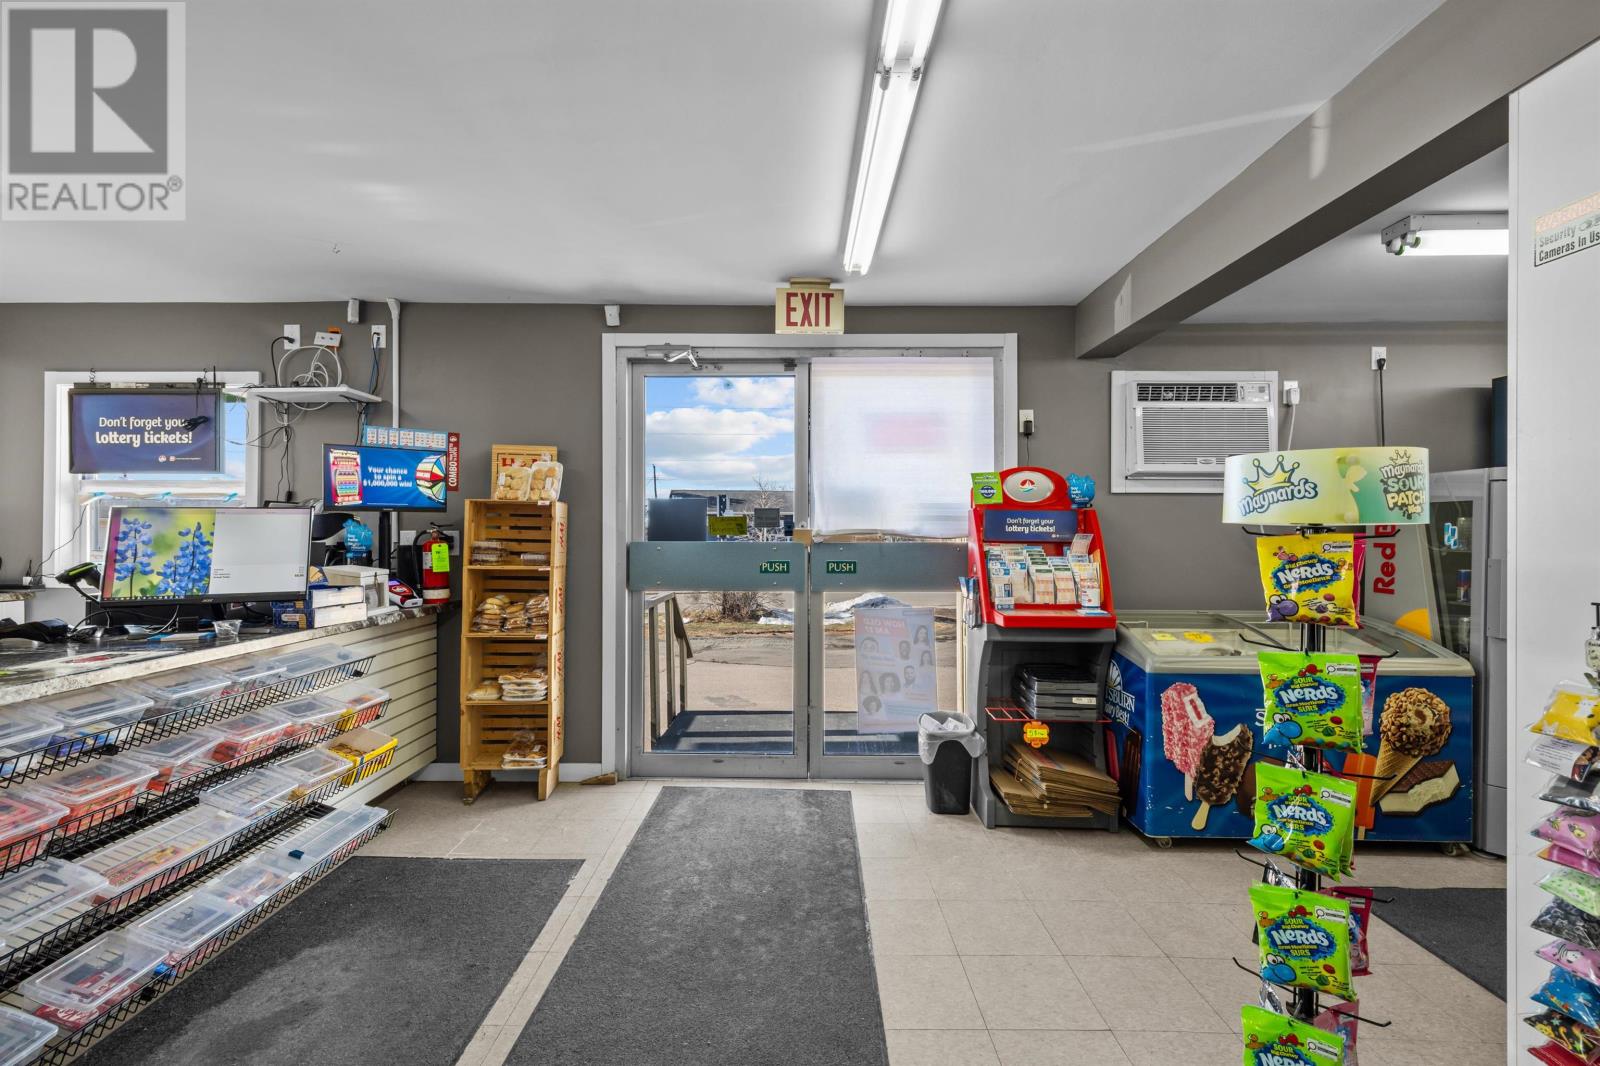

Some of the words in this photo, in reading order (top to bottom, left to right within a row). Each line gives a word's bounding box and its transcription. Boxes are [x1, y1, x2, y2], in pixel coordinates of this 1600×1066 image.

[1540, 224, 1577, 247] Security
[1539, 240, 1576, 262] Cameras
[1578, 236, 1587, 247] In
[1589, 230, 1600, 244] Us
[785, 292, 834, 327] EXIT
[98, 416, 127, 428] Don't
[129, 416, 162, 430] forget
[164, 418, 190, 430] you
[96, 431, 141, 448] lottery
[144, 431, 193, 444] tickets!
[367, 466, 384, 474] Your
[385, 467, 408, 475] chance
[448, 460, 458, 487] COMBO
[363, 478, 398, 488] $1,000,000
[1386, 477, 1426, 493] SOUR
[1238, 477, 1318, 516] Maynards
[1386, 492, 1426, 509] PATCH
[1006, 517, 1022, 525] Don't
[1022, 518, 1040, 526] forget
[1006, 524, 1030, 534] lottery
[762, 562, 788, 572] PUSH
[828, 562, 854, 572] PUSH
[1374, 542, 1396, 594] Red
[1273, 1044, 1294, 1054] SOUR
